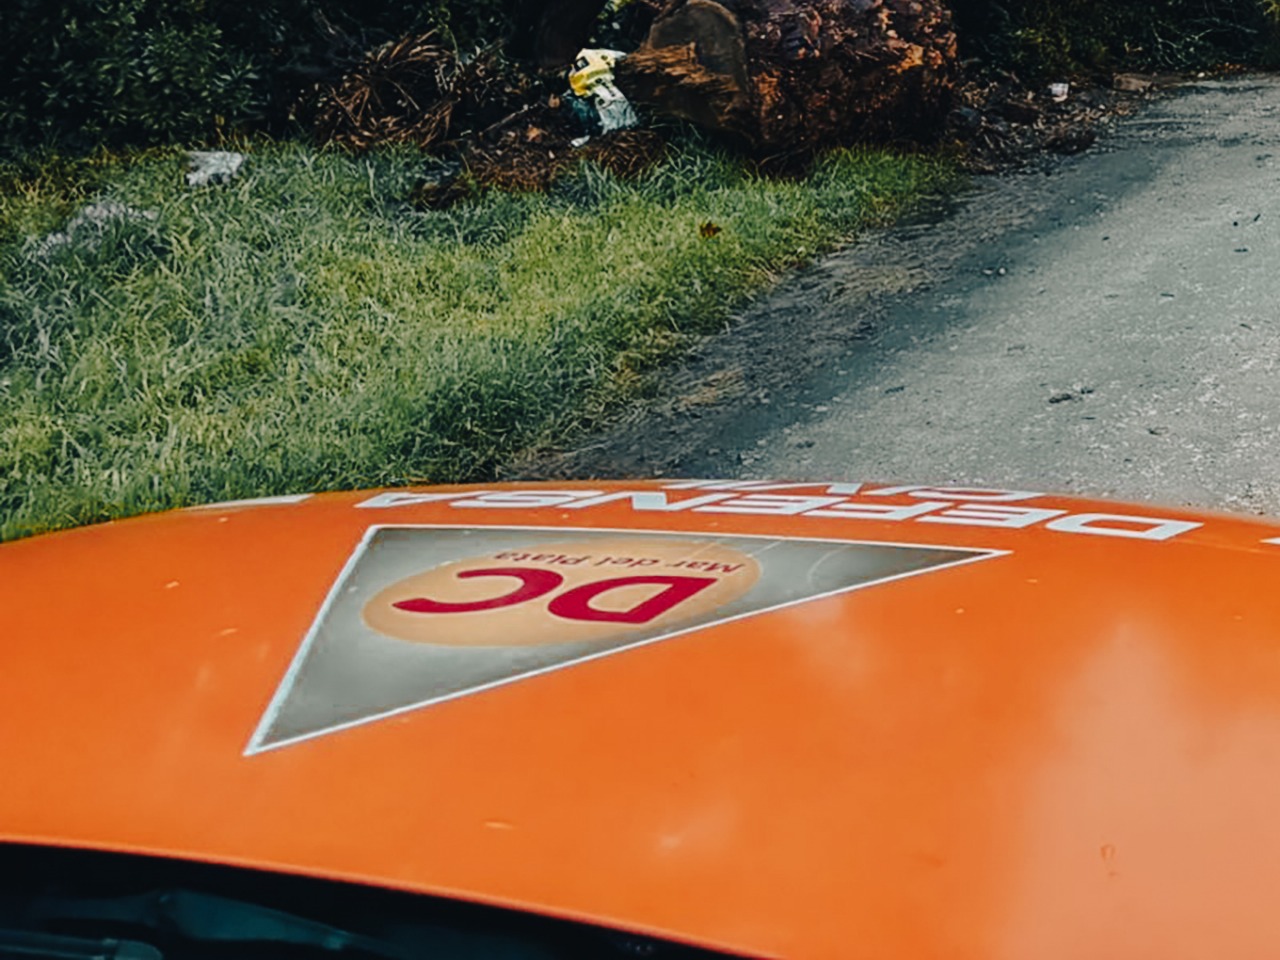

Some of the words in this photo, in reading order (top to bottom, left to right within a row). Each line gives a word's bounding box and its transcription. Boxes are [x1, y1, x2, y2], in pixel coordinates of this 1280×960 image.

[353, 491, 1204, 540] DEFENSA
[495, 551, 586, 567] Plata
[598, 555, 659, 567] del
[668, 561, 746, 574] Mar
[391, 567, 718, 624] DC
